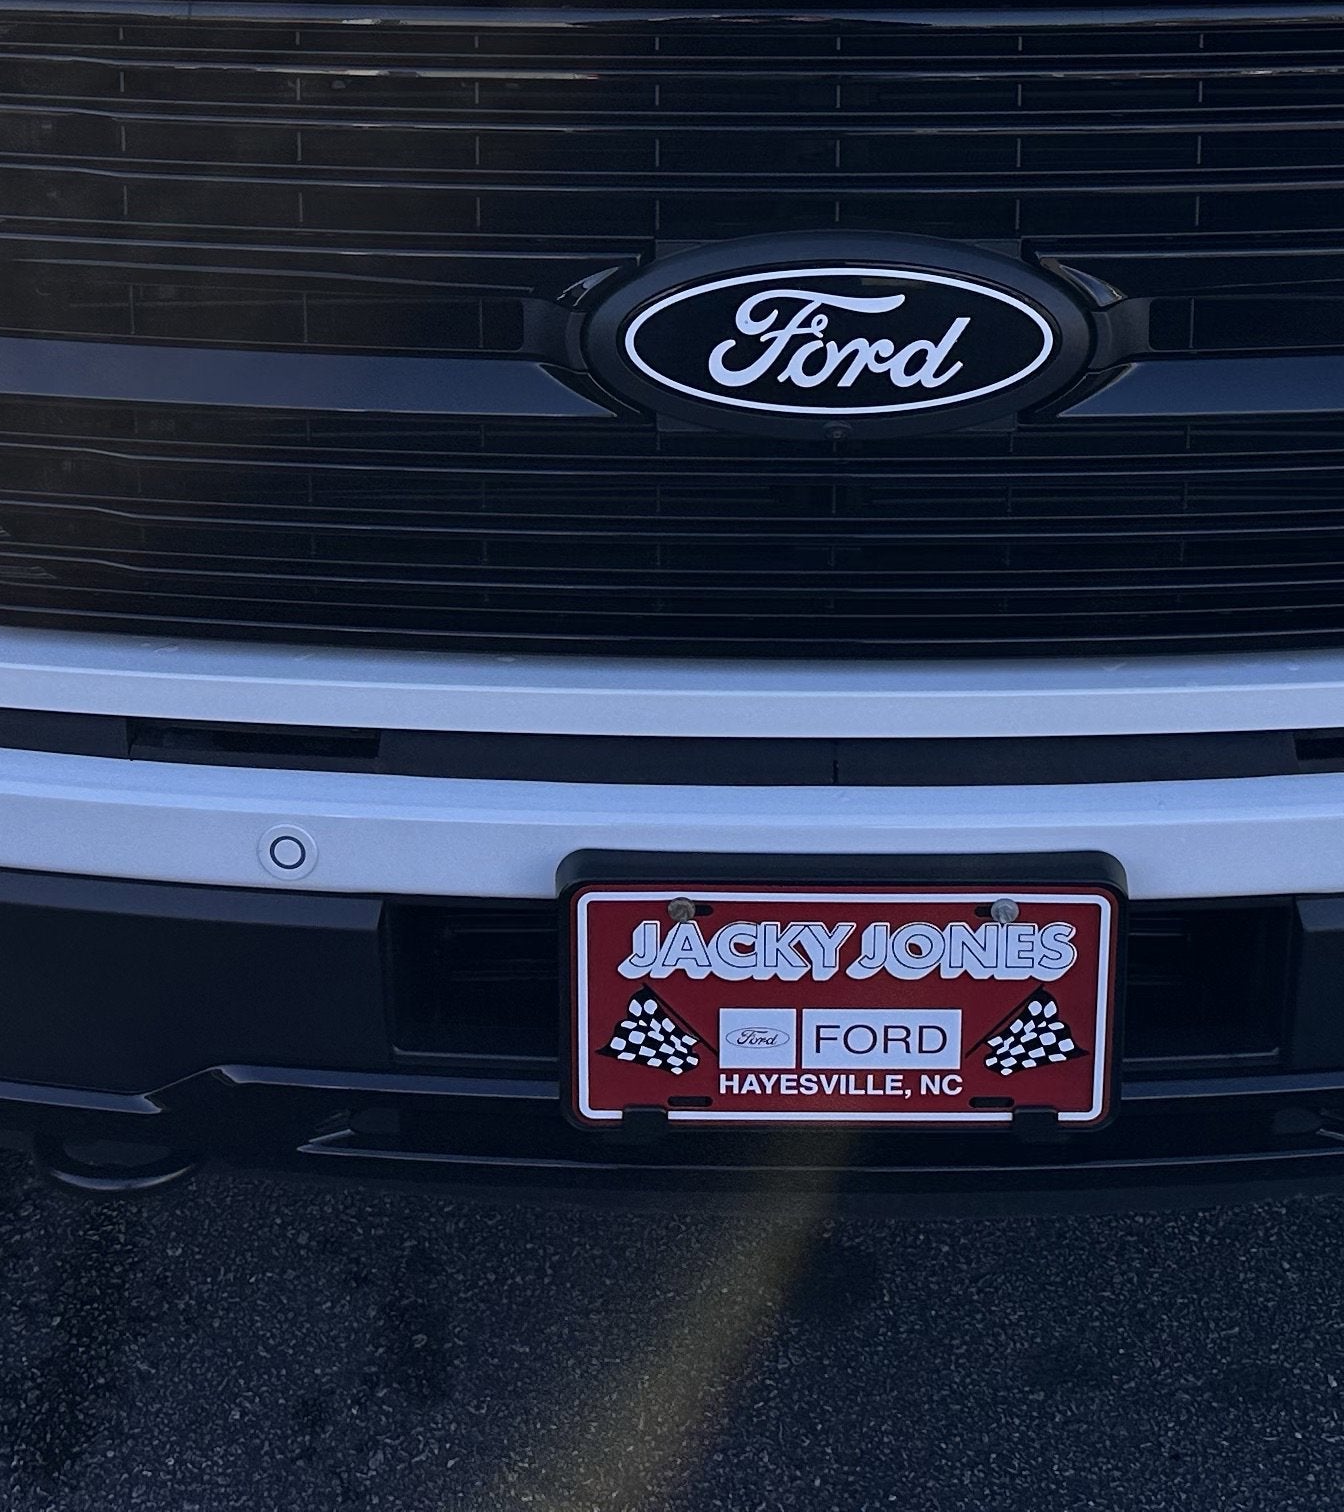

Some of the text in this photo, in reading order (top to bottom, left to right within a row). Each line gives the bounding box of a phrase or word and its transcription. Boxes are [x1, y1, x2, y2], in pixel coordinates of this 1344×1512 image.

[708, 289, 971, 389] Ford
[617, 920, 1078, 981] JACKY JONES
[737, 1029, 778, 1046] Ford
[815, 1024, 948, 1055] FORD
[719, 1073, 964, 1099] HAYESVILLE, NC
